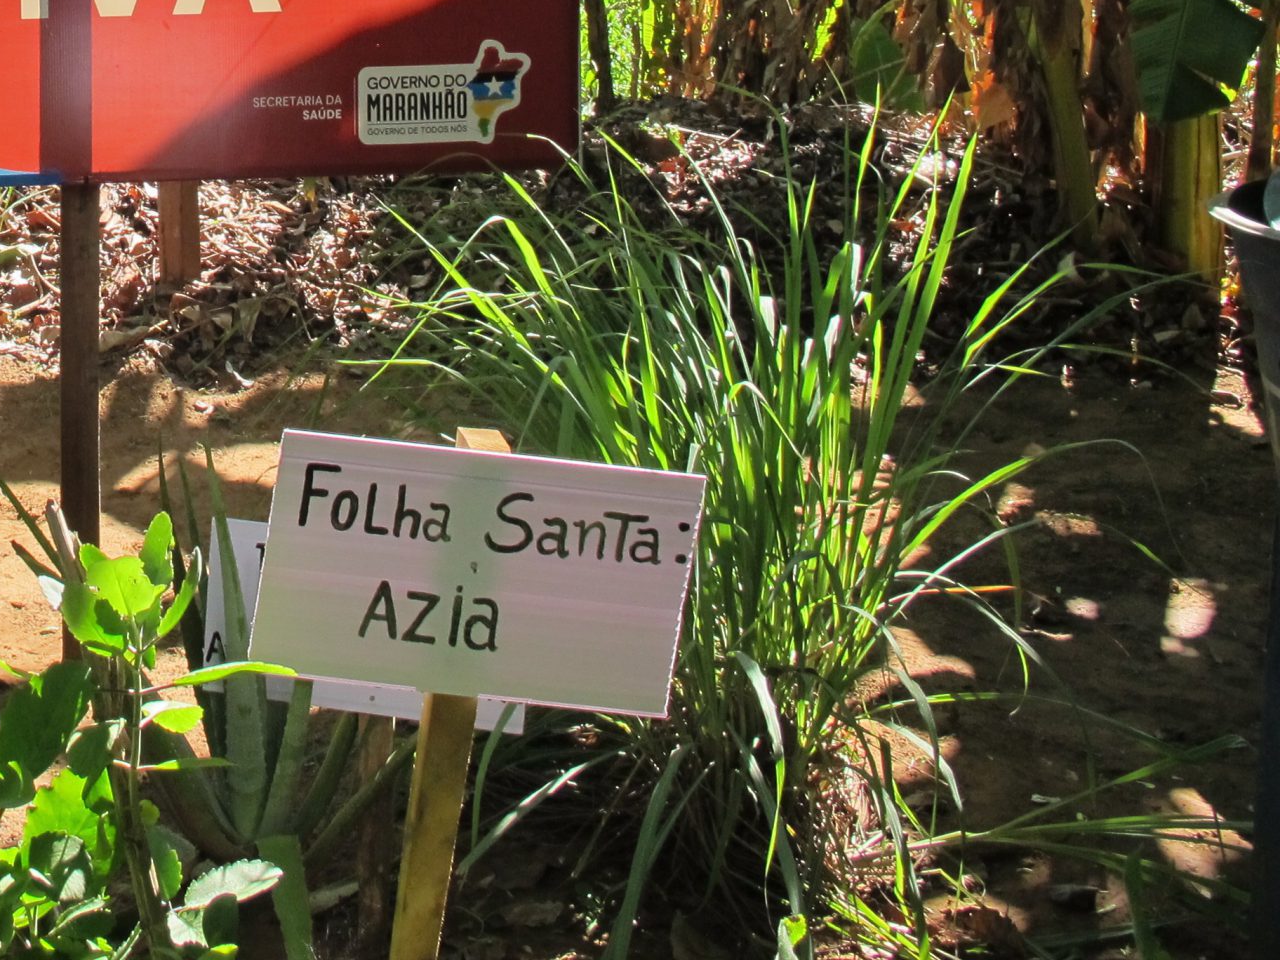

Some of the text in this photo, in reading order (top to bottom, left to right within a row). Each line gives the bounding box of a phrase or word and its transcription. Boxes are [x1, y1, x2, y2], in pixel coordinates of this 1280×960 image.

[367, 74, 467, 90] GOVERNO DO
[252, 94, 343, 108] SECRETARIA DA
[367, 88, 468, 122] MARANHÃO
[302, 106, 343, 120] SAÚDE
[367, 126, 406, 136] GOVERNO
[407, 126, 419, 135] DE
[421, 125, 449, 134] TODOS
